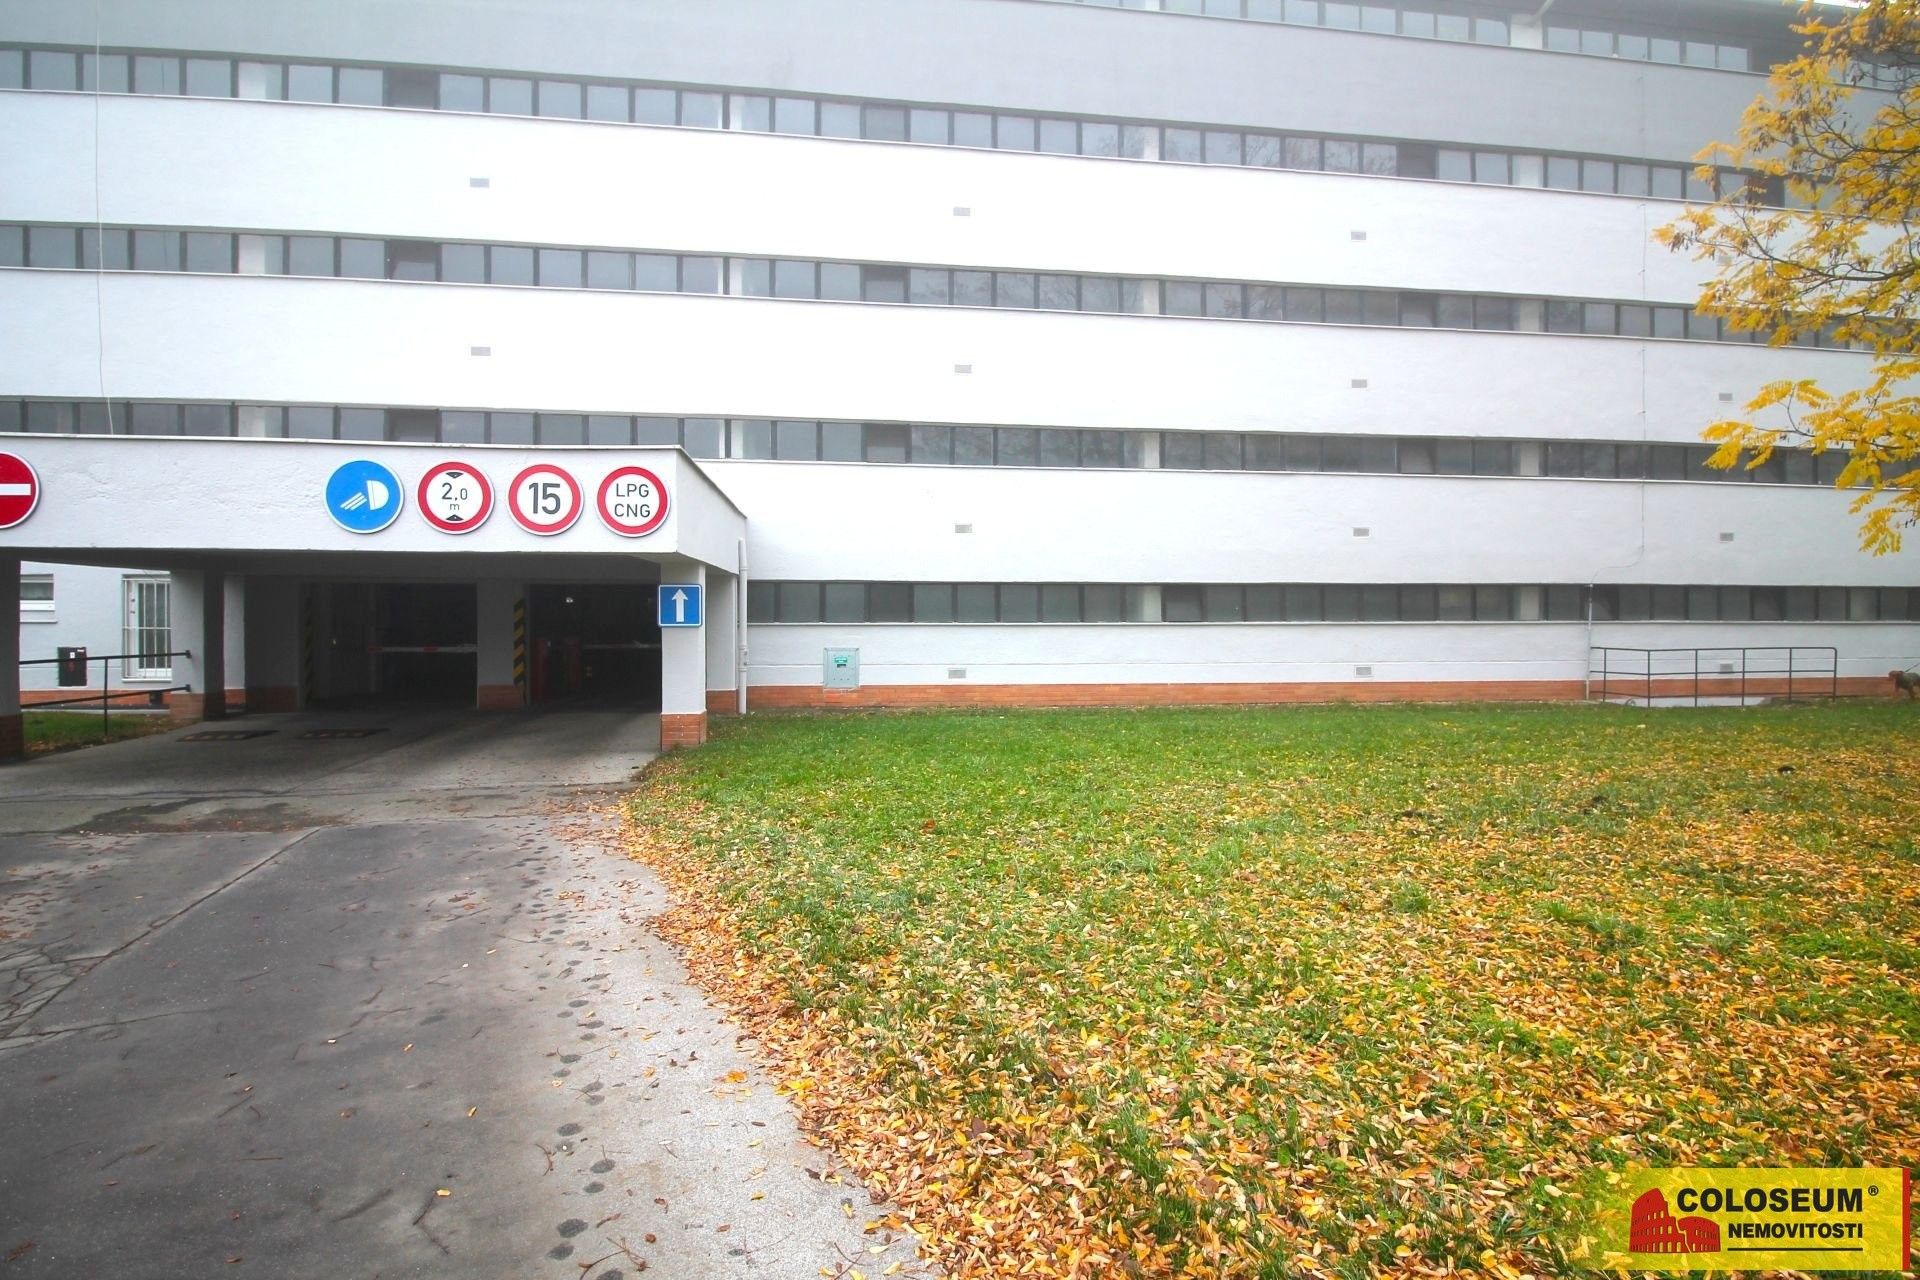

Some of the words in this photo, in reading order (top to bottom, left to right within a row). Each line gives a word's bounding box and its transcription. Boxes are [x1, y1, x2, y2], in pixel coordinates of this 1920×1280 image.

[528, 482, 561, 514] 15
[615, 483, 649, 498] LPG
[613, 503, 651, 518] CNG
